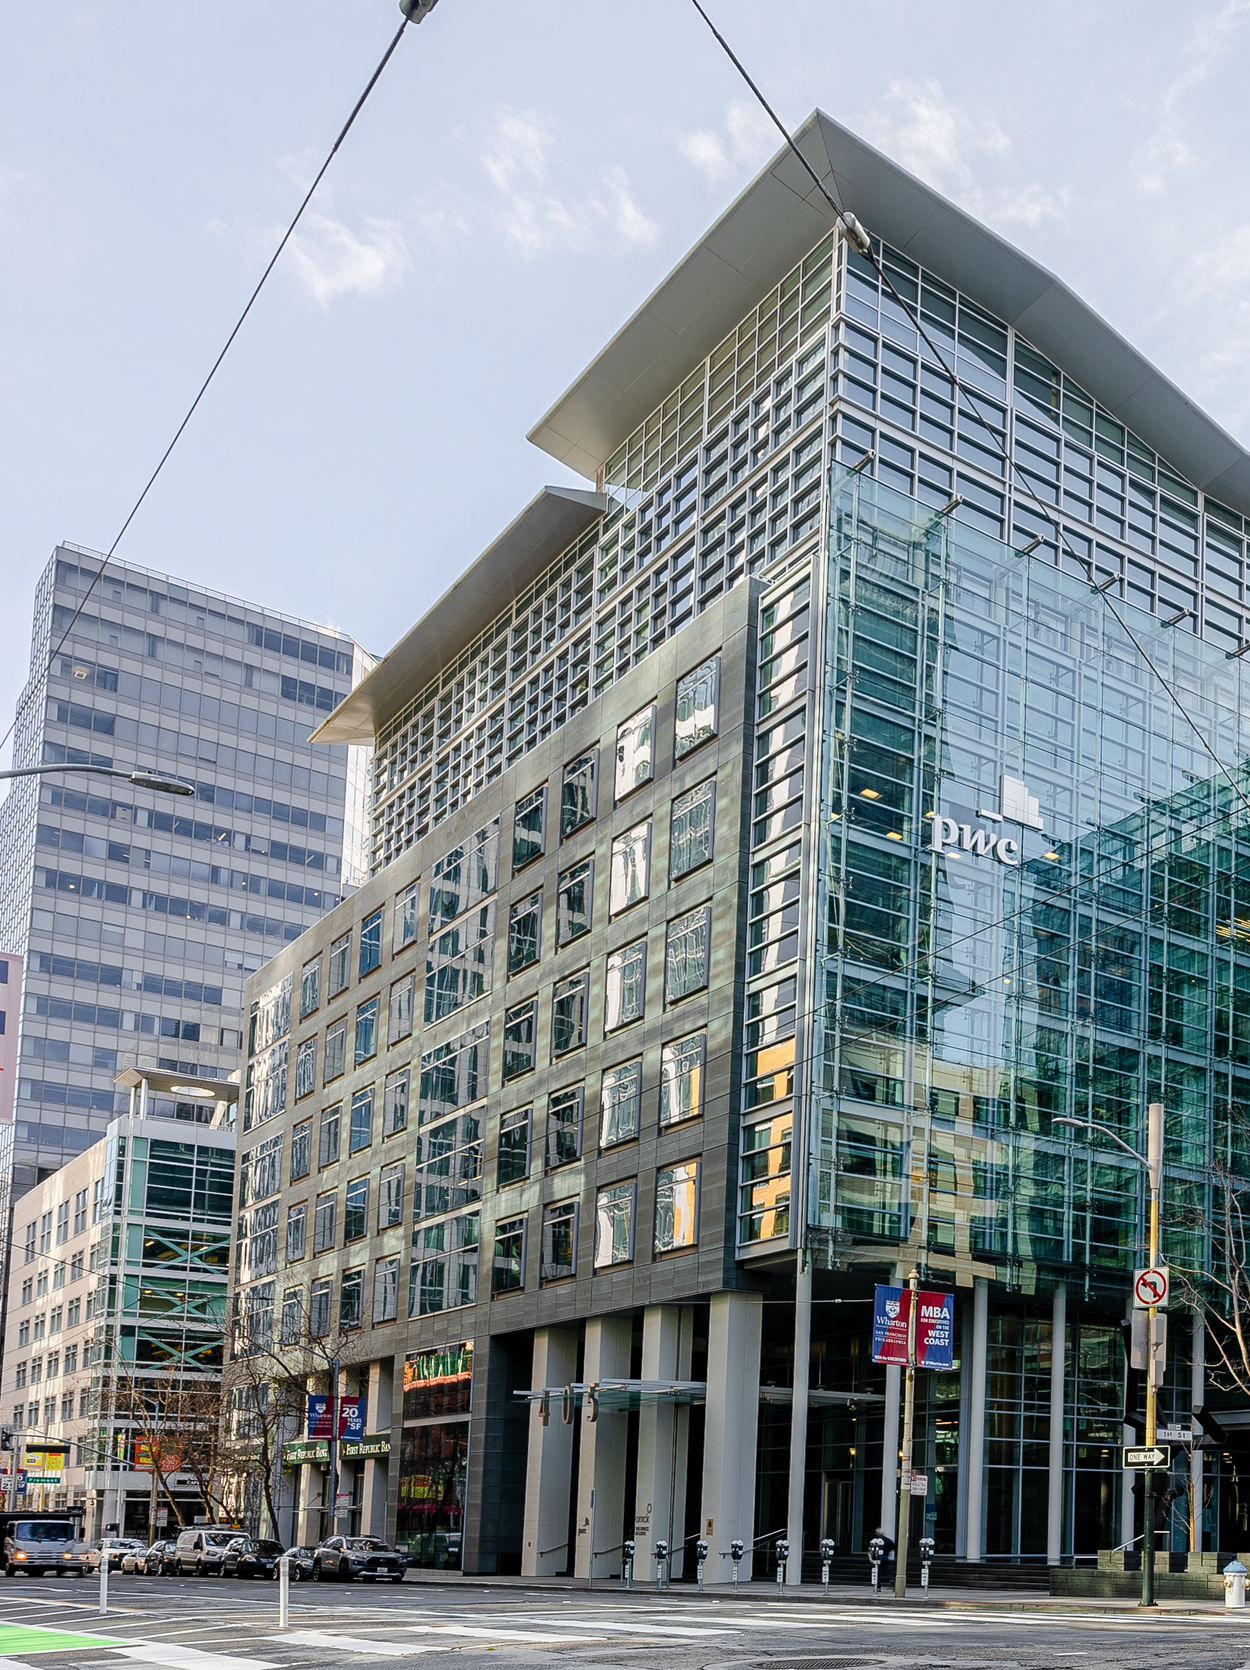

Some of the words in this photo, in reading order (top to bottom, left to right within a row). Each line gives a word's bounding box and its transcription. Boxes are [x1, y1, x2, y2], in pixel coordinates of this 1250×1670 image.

[931, 814, 1019, 866] pwc
[921, 1305, 950, 1319] MBA
[876, 1315, 907, 1328] Wharton
[927, 1329, 950, 1338] WEST
[924, 1338, 949, 1346] COAST
[538, 1383, 599, 1427] 405
[341, 1407, 359, 1418] 20
[350, 1423, 362, 1431] SF
[359, 1442, 381, 1455] REPUBLIC
